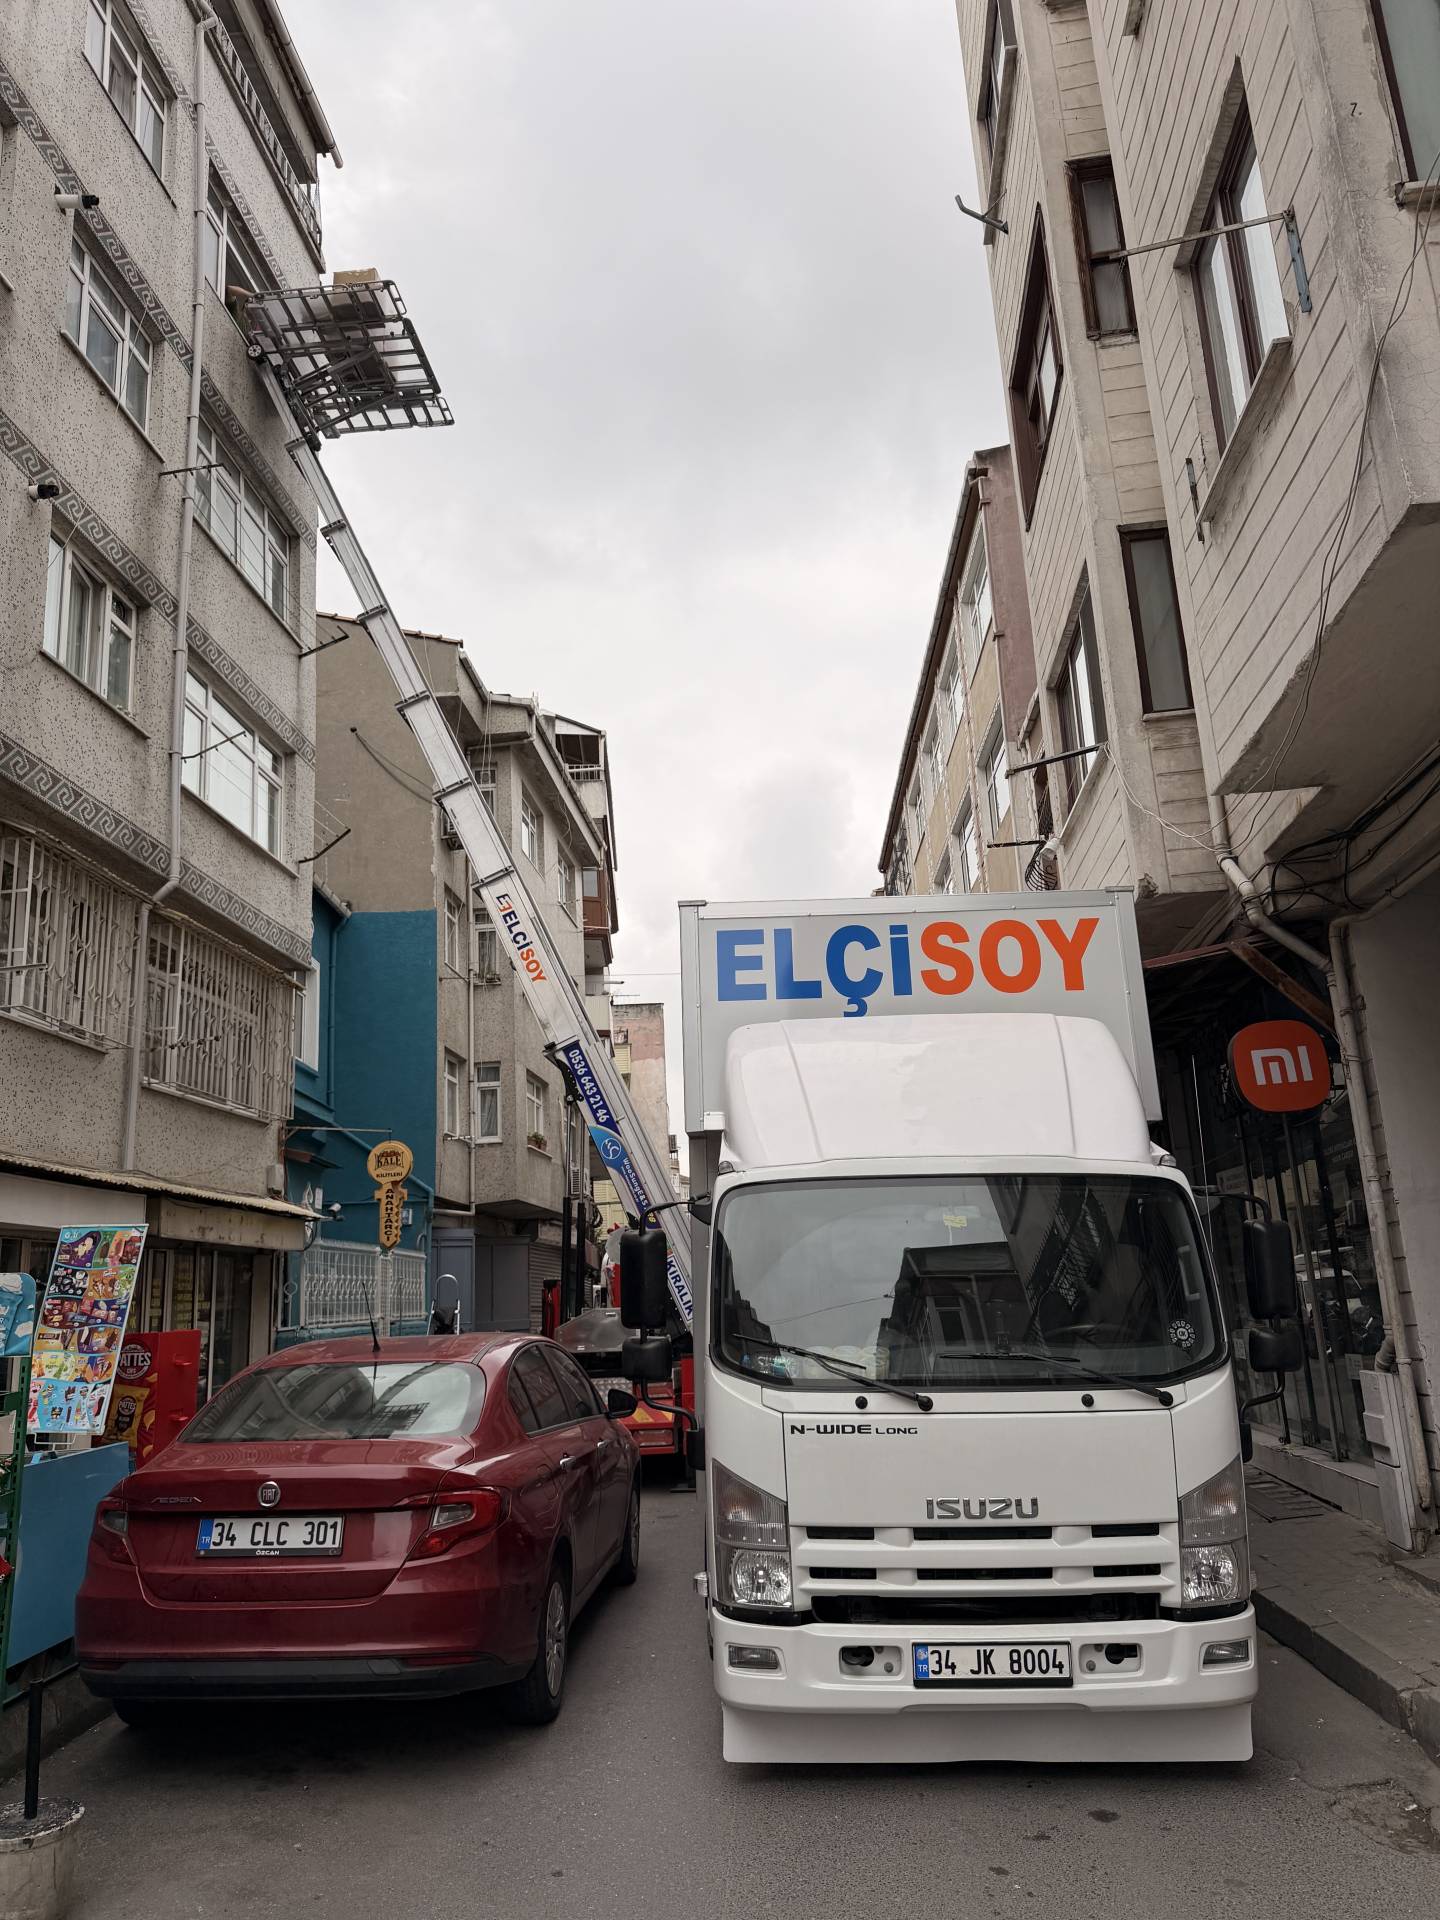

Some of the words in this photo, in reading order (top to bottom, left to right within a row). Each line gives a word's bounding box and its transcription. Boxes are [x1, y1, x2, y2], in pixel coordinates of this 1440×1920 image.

[568, 1049, 587, 1076] 0536
[581, 1076, 598, 1096] 643
[589, 1095, 603, 1110] 21
[596, 1109, 610, 1123] 46
[376, 1153, 404, 1170] KALE
[119, 1351, 152, 1367] ATTES
[790, 1424, 872, 1435] N-WIDE
[875, 1427, 918, 1435] LONG
[262, 1488, 276, 1500] FIAT
[925, 1496, 1040, 1520] ISUZU
[201, 1536, 211, 1544] TR
[212, 1522, 237, 1547] 34
[250, 1521, 290, 1547] CLC
[303, 1520, 338, 1546] 301
[917, 1664, 928, 1673] TR
[930, 1649, 957, 1675] 34
[969, 1649, 996, 1675] JK
[1009, 1649, 1065, 1675] 8004
